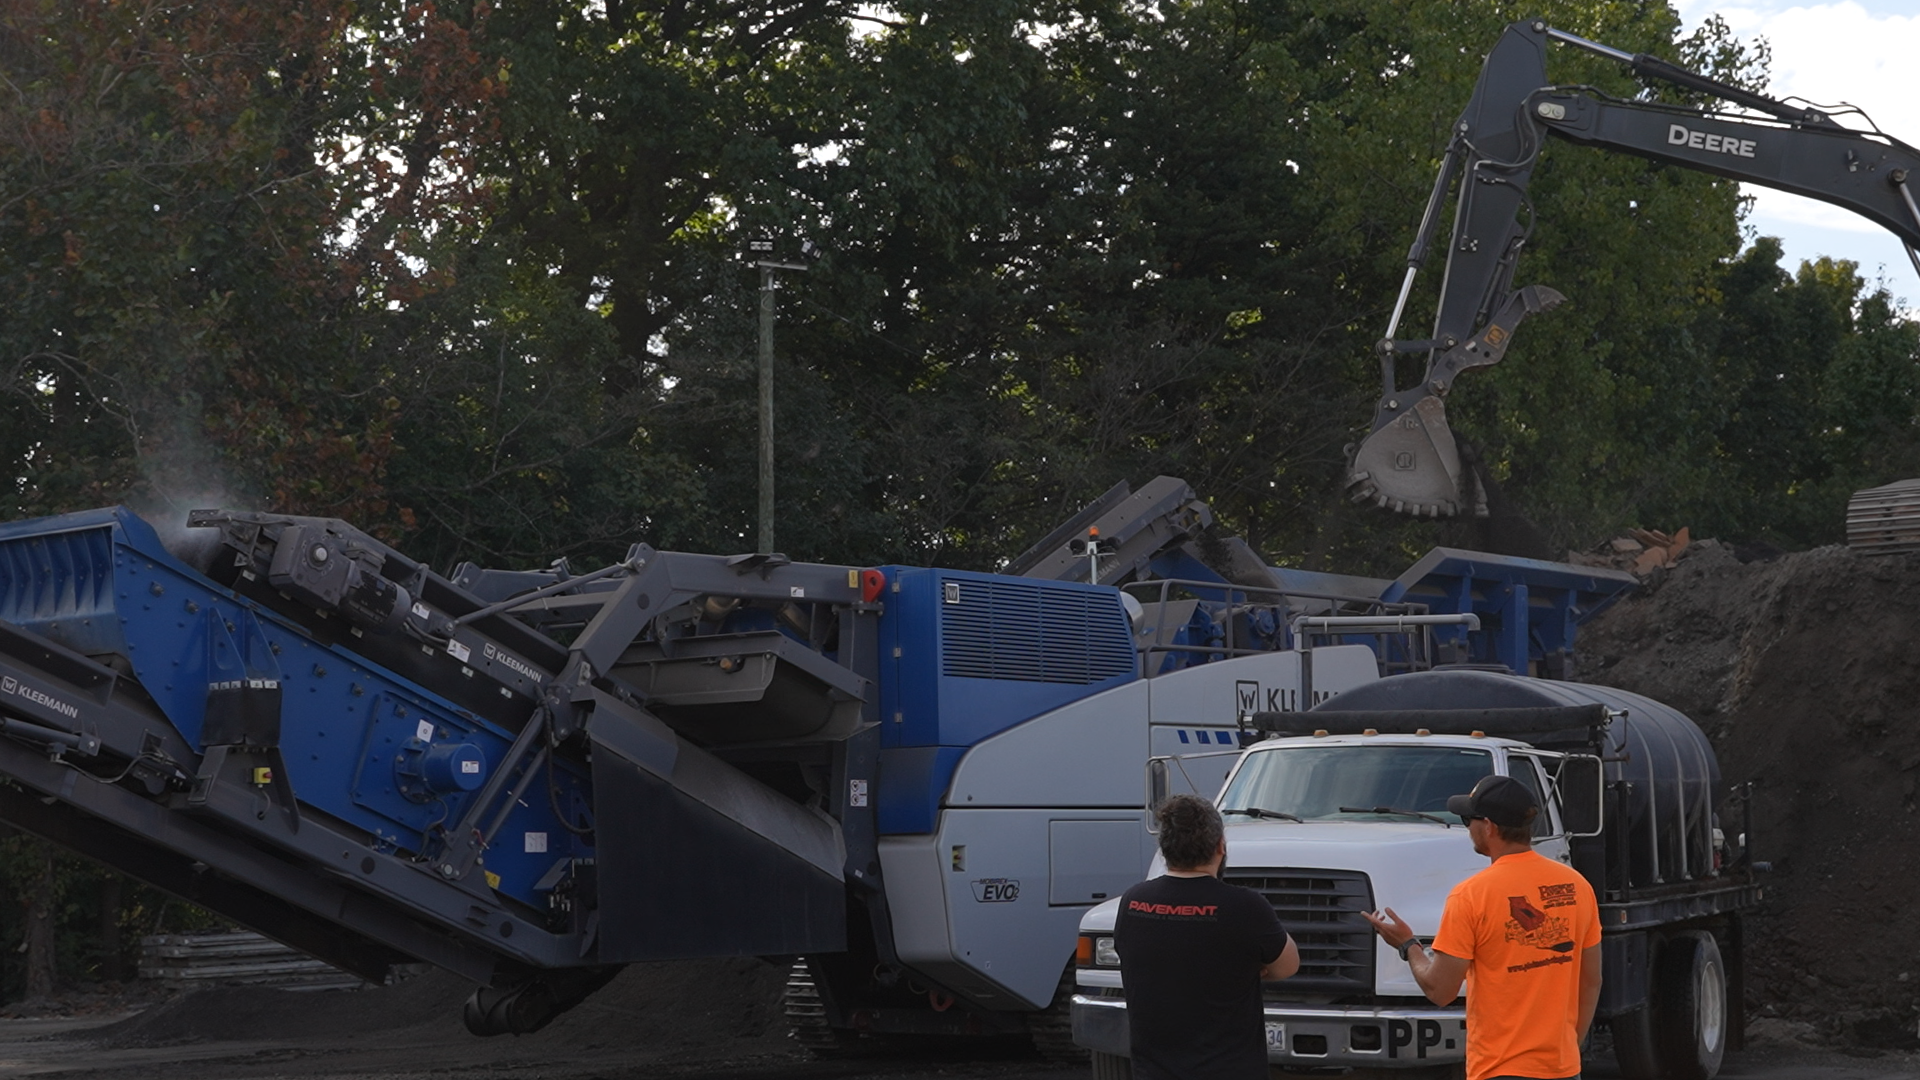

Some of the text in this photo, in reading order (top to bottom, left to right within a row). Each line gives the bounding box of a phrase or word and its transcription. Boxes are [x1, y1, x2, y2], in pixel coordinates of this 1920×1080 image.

[496, 651, 542, 683] KLEEMANN
[18, 685, 78, 719] KLEEMANN
[1128, 900, 1218, 916] PAVEMENT
